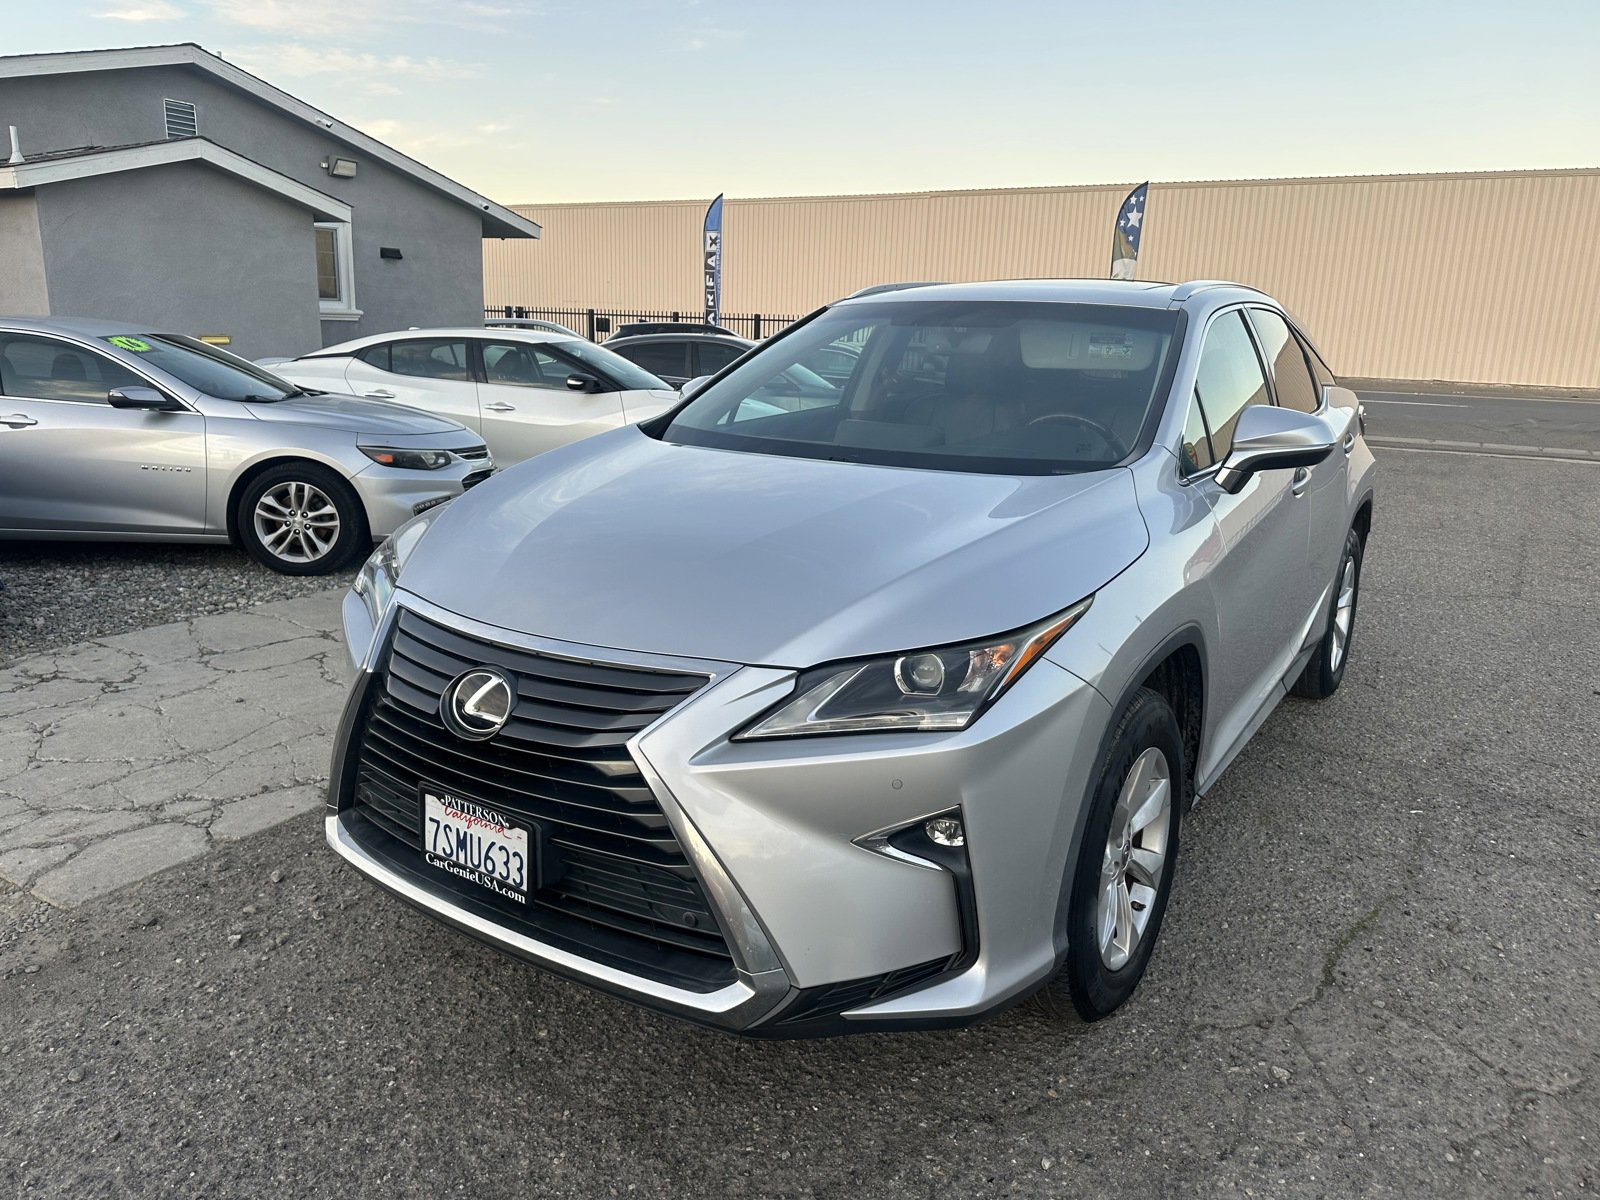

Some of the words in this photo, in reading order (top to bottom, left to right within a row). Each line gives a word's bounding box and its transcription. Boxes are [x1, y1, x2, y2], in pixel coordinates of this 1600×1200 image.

[706, 235, 717, 326] ARFAX
[443, 794, 508, 827] PATTERSON
[425, 852, 526, 905] CarGenieUSA.com
[428, 816, 525, 888] 7SMU633
